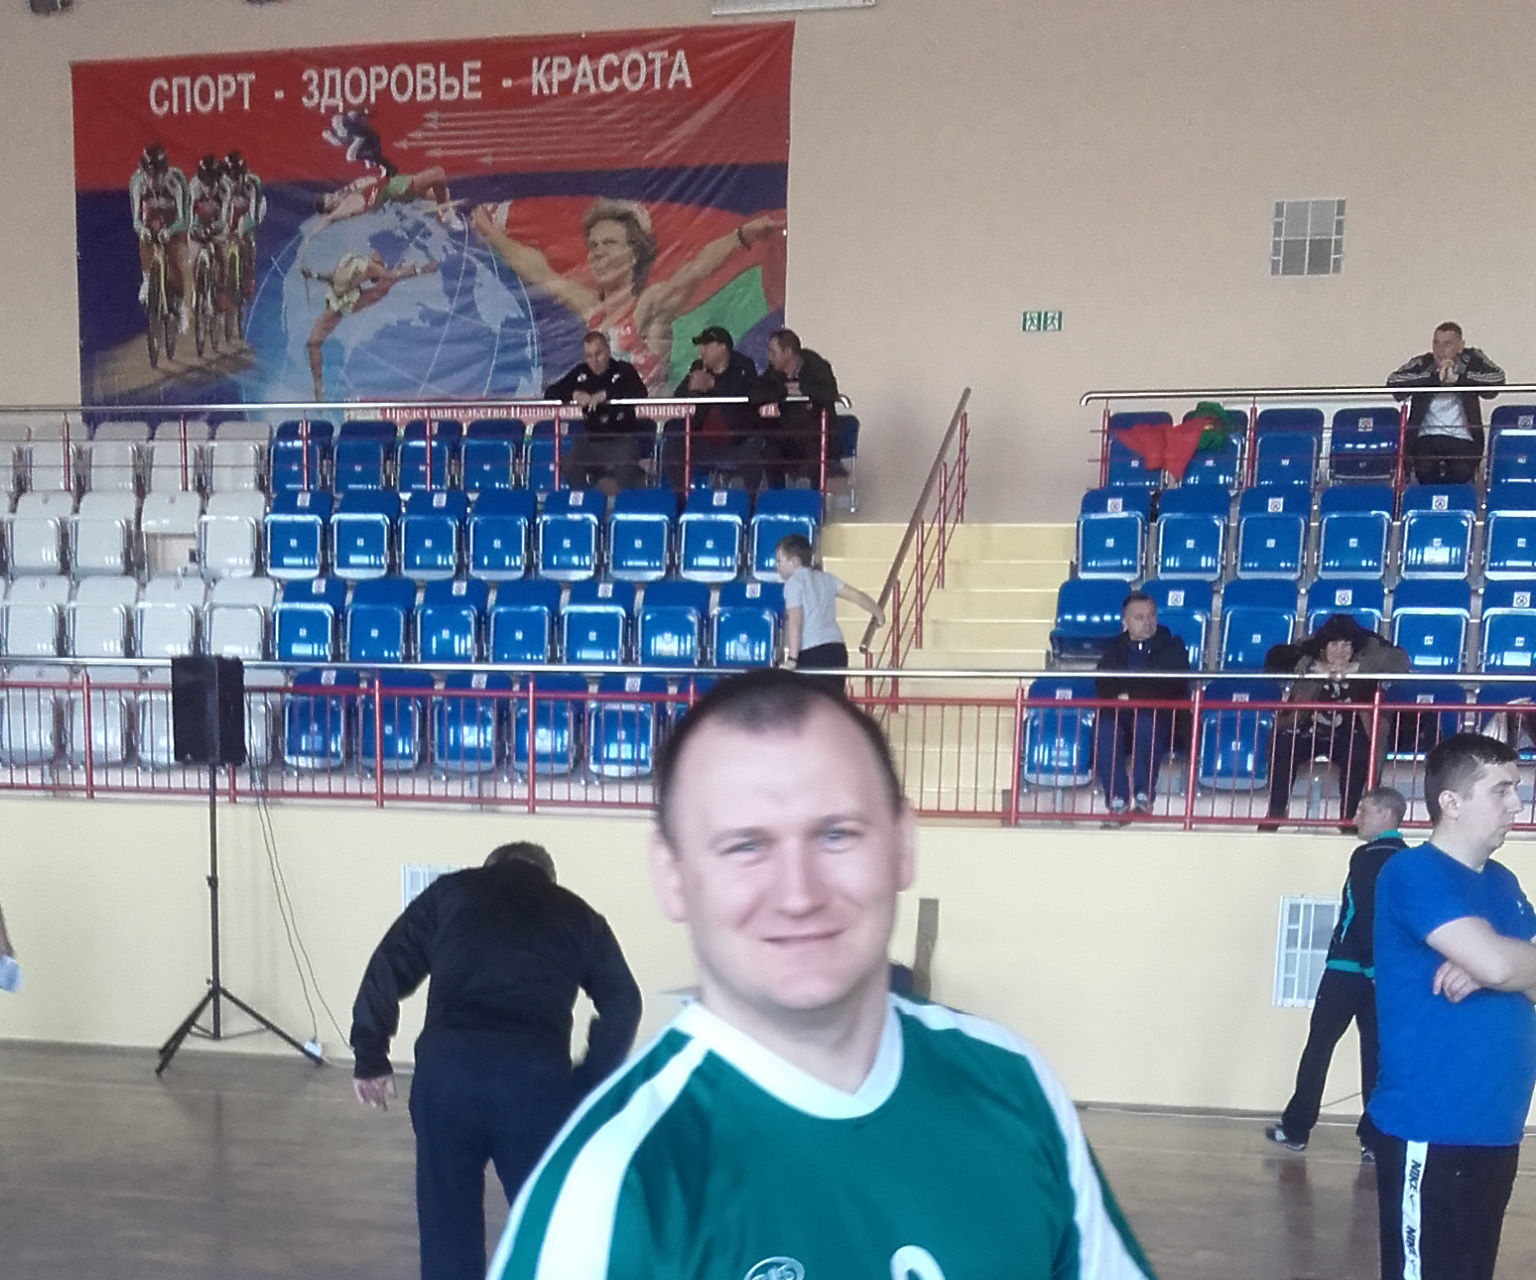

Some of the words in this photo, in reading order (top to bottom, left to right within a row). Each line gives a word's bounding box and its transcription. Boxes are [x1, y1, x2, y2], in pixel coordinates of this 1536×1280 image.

[150, 72, 255, 115] СПОРТ
[301, 60, 482, 113] ЗДОРОВЬЕ
[532, 49, 692, 96] КРАСОТА
[386, 406, 506, 421] Представительство
